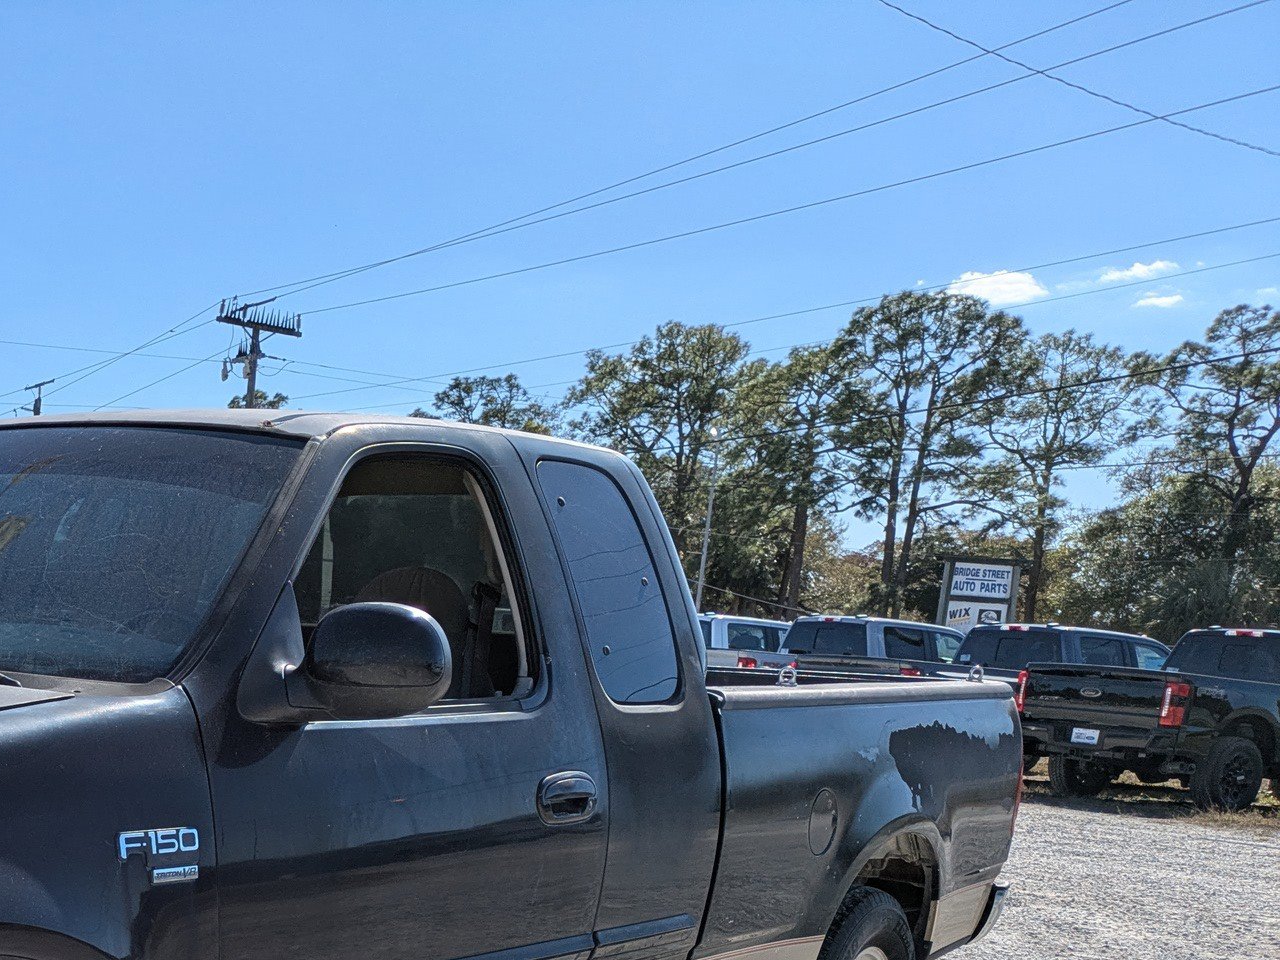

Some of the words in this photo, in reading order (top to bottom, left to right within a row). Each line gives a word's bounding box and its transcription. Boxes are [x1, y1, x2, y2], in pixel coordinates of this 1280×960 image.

[954, 566, 981, 578] BRIDGE
[982, 568, 1011, 580] STREET
[952, 580, 976, 592] AUTO
[980, 582, 1008, 594] PARTS
[949, 607, 971, 619] WIX
